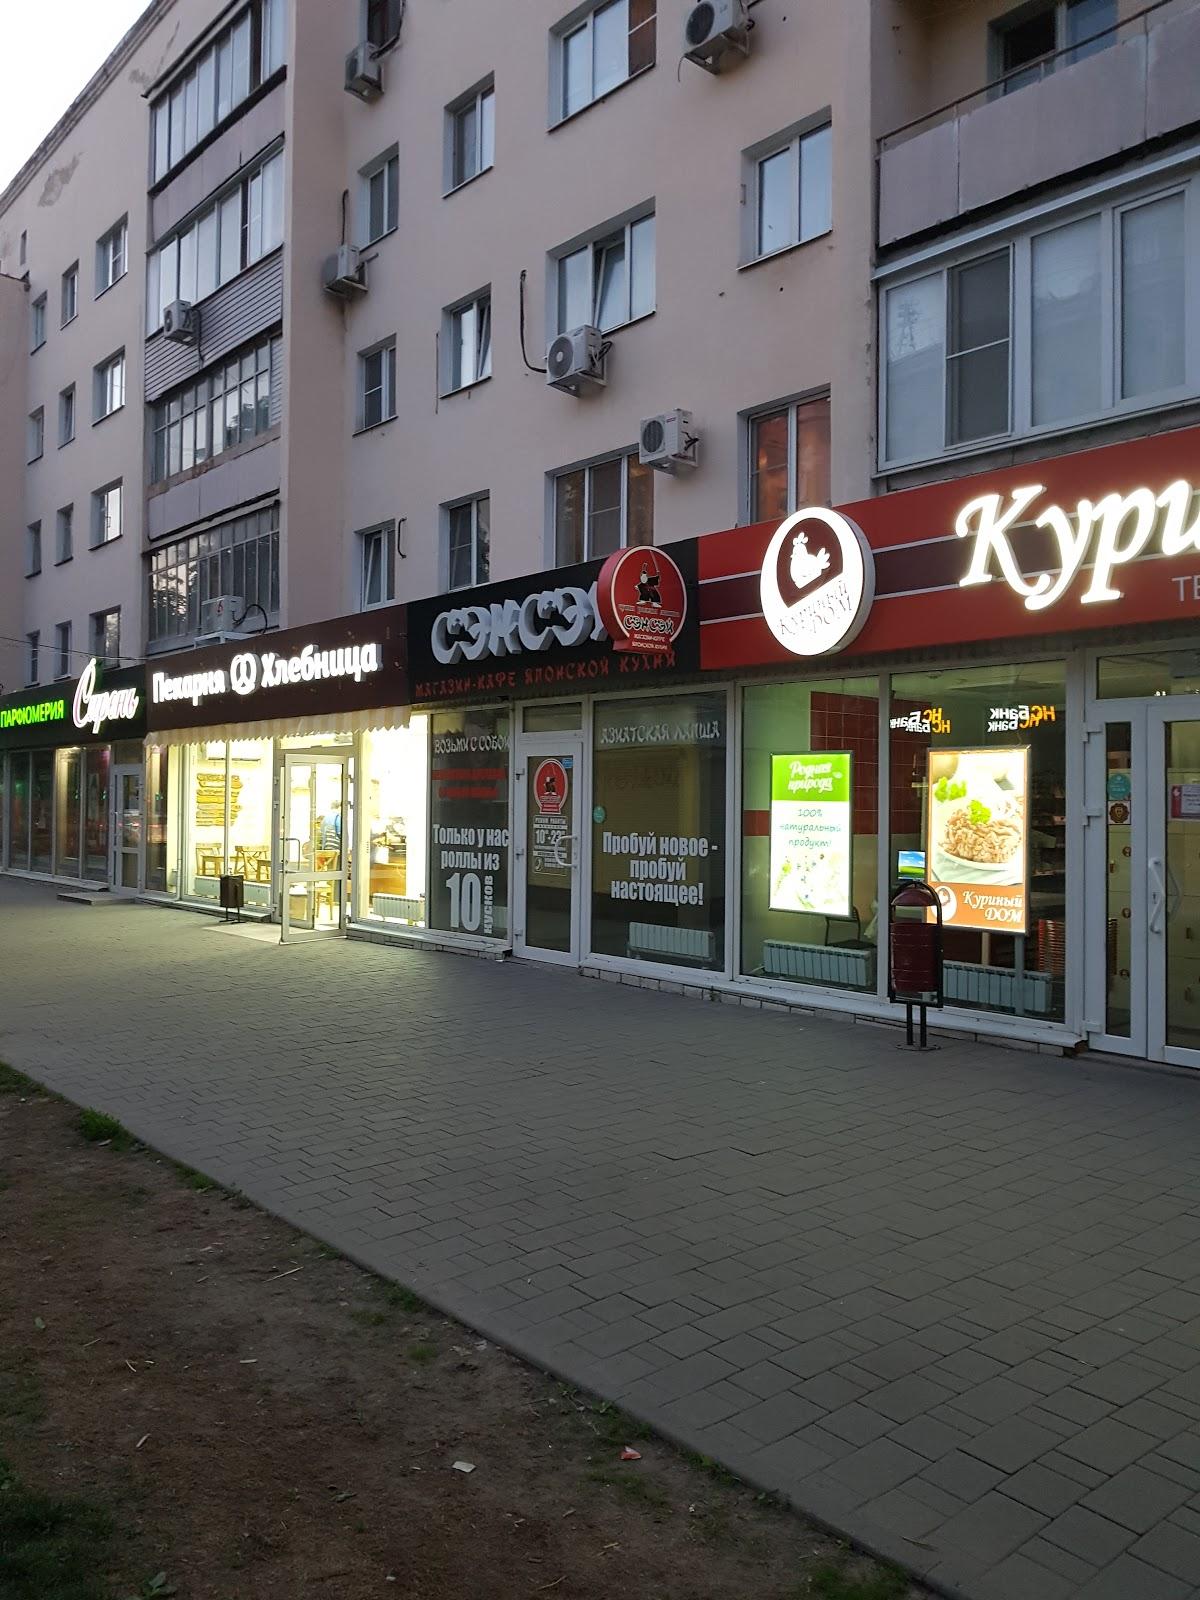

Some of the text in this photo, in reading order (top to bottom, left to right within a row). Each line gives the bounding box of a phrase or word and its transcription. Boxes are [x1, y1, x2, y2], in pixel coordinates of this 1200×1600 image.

[431, 580, 607, 664] СЭНСЭ
[152, 643, 378, 707] Пекарня Хлебница
[415, 651, 676, 697] МАГАЗИН-КАФЕ ЯПОНСКОЙ КУХНИ
[0, 700, 65, 728] ПАРФЮМЕРИЯ
[434, 738, 469, 754] ВОЗЬМИ
[798, 808, 823, 817] 100%
[432, 824, 509, 848] Только у нас
[603, 831, 657, 857] Пробуй
[660, 836, 709, 857] новое
[441, 850, 500, 871] роллы из
[629, 857, 686, 882] пробуй
[446, 872, 482, 932] 10
[611, 880, 704, 907] настоящее!
[962, 890, 1023, 910] Куриный
